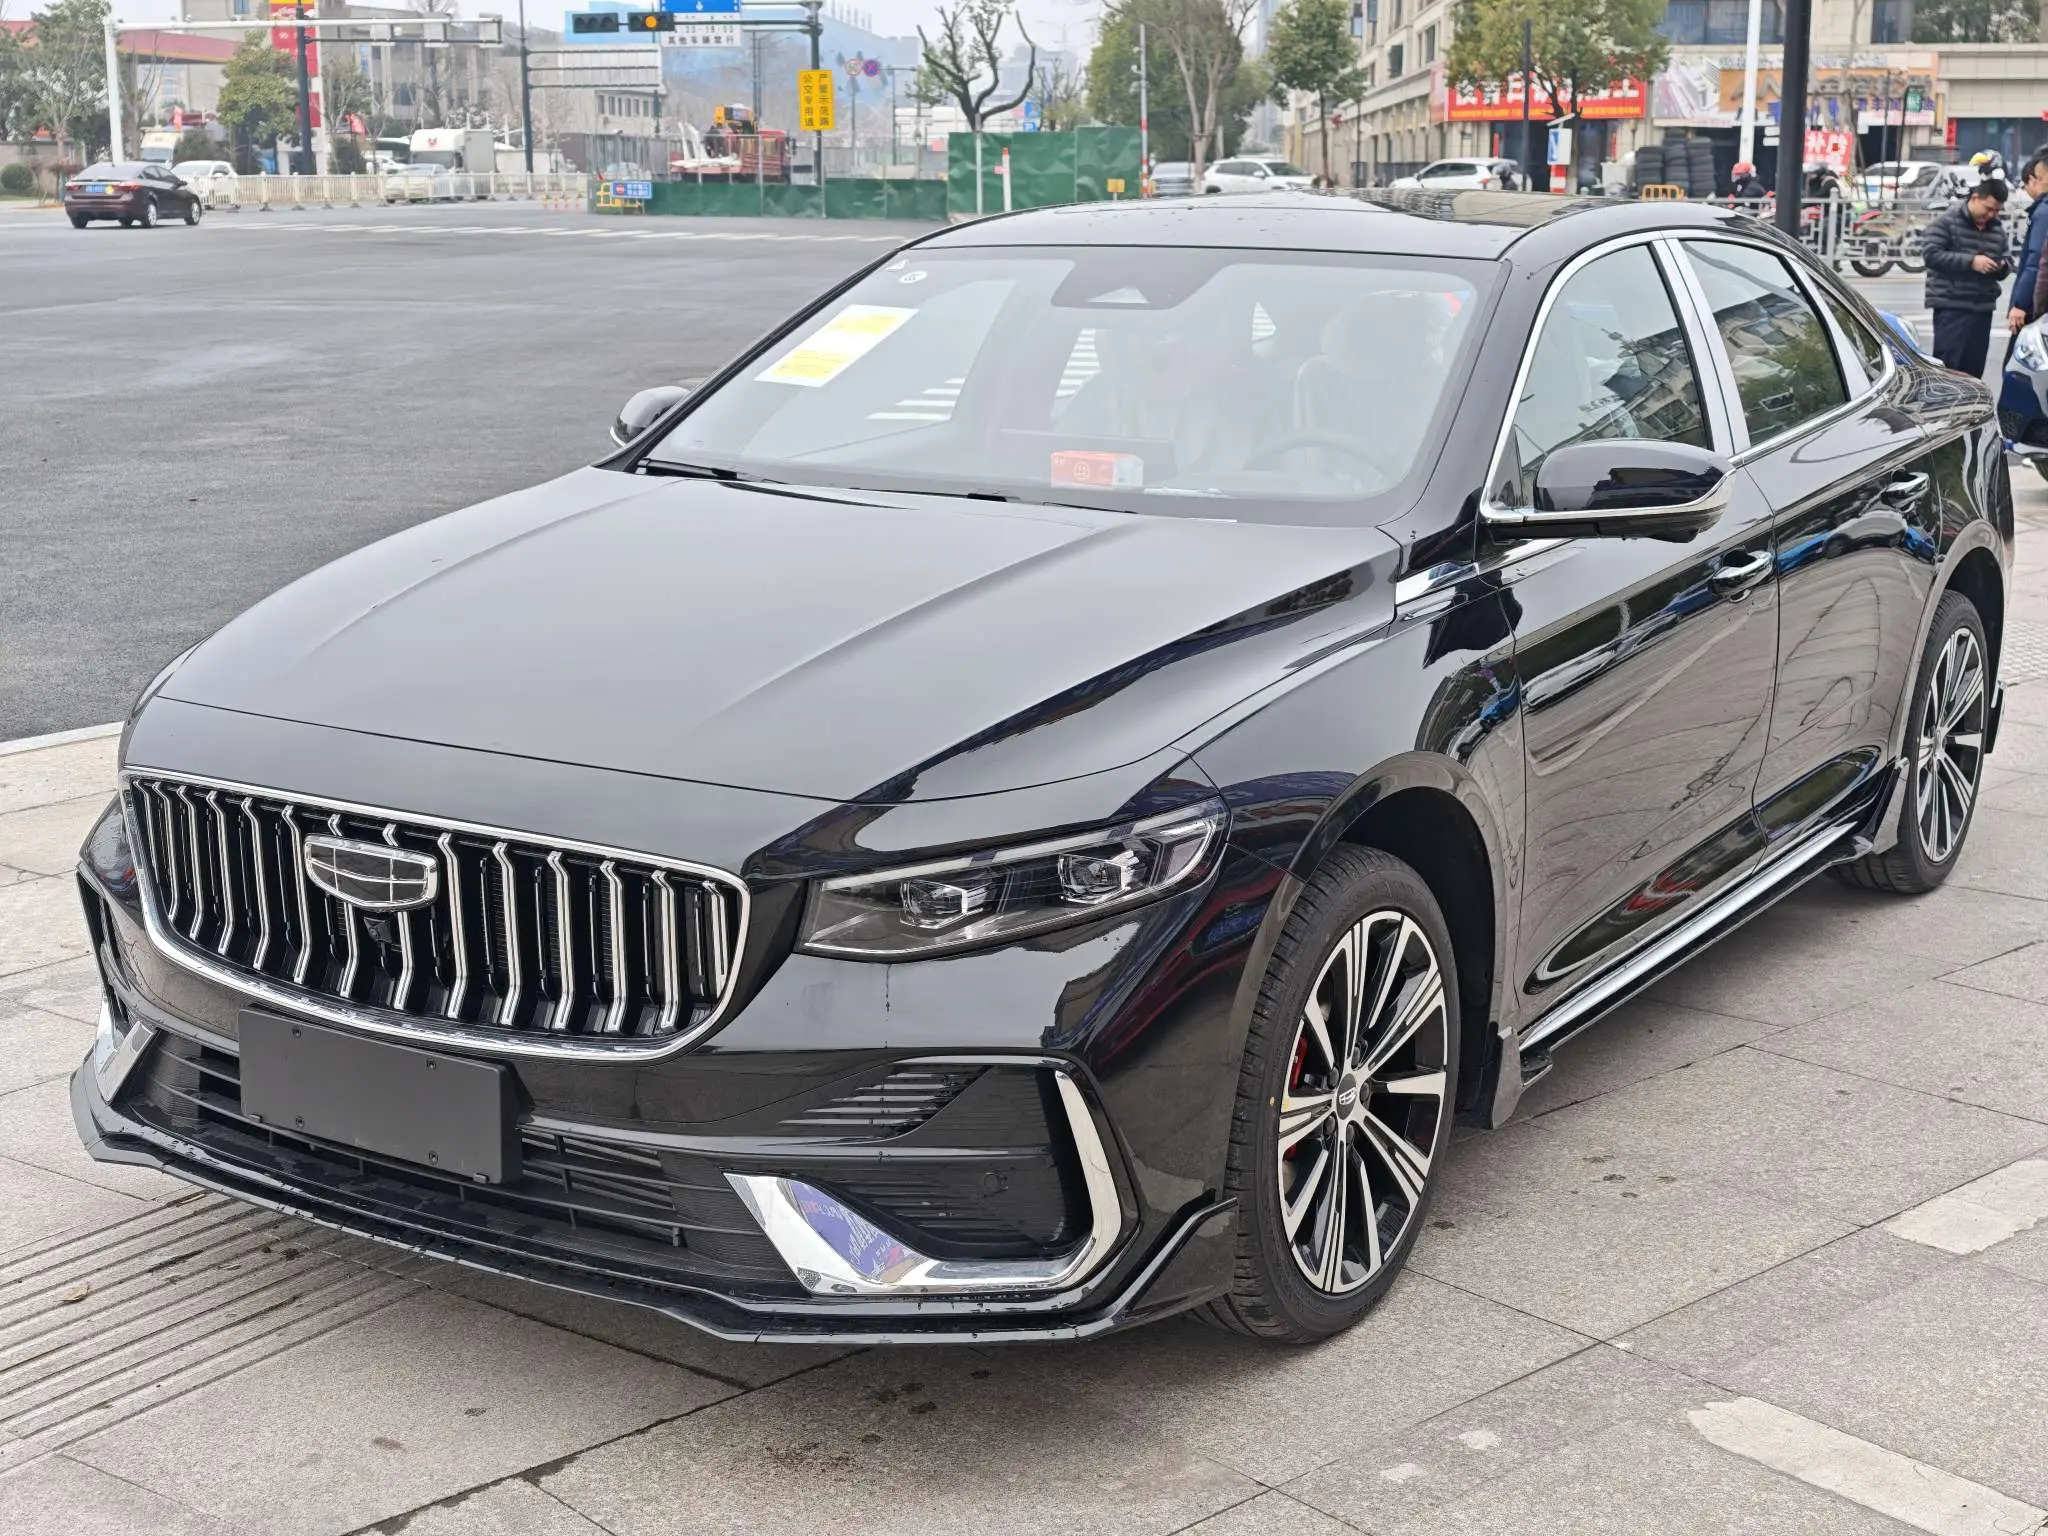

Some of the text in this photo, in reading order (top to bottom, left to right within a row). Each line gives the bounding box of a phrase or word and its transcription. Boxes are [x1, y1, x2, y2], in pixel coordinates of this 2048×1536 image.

[803, 74, 814, 127] 公交专用道
